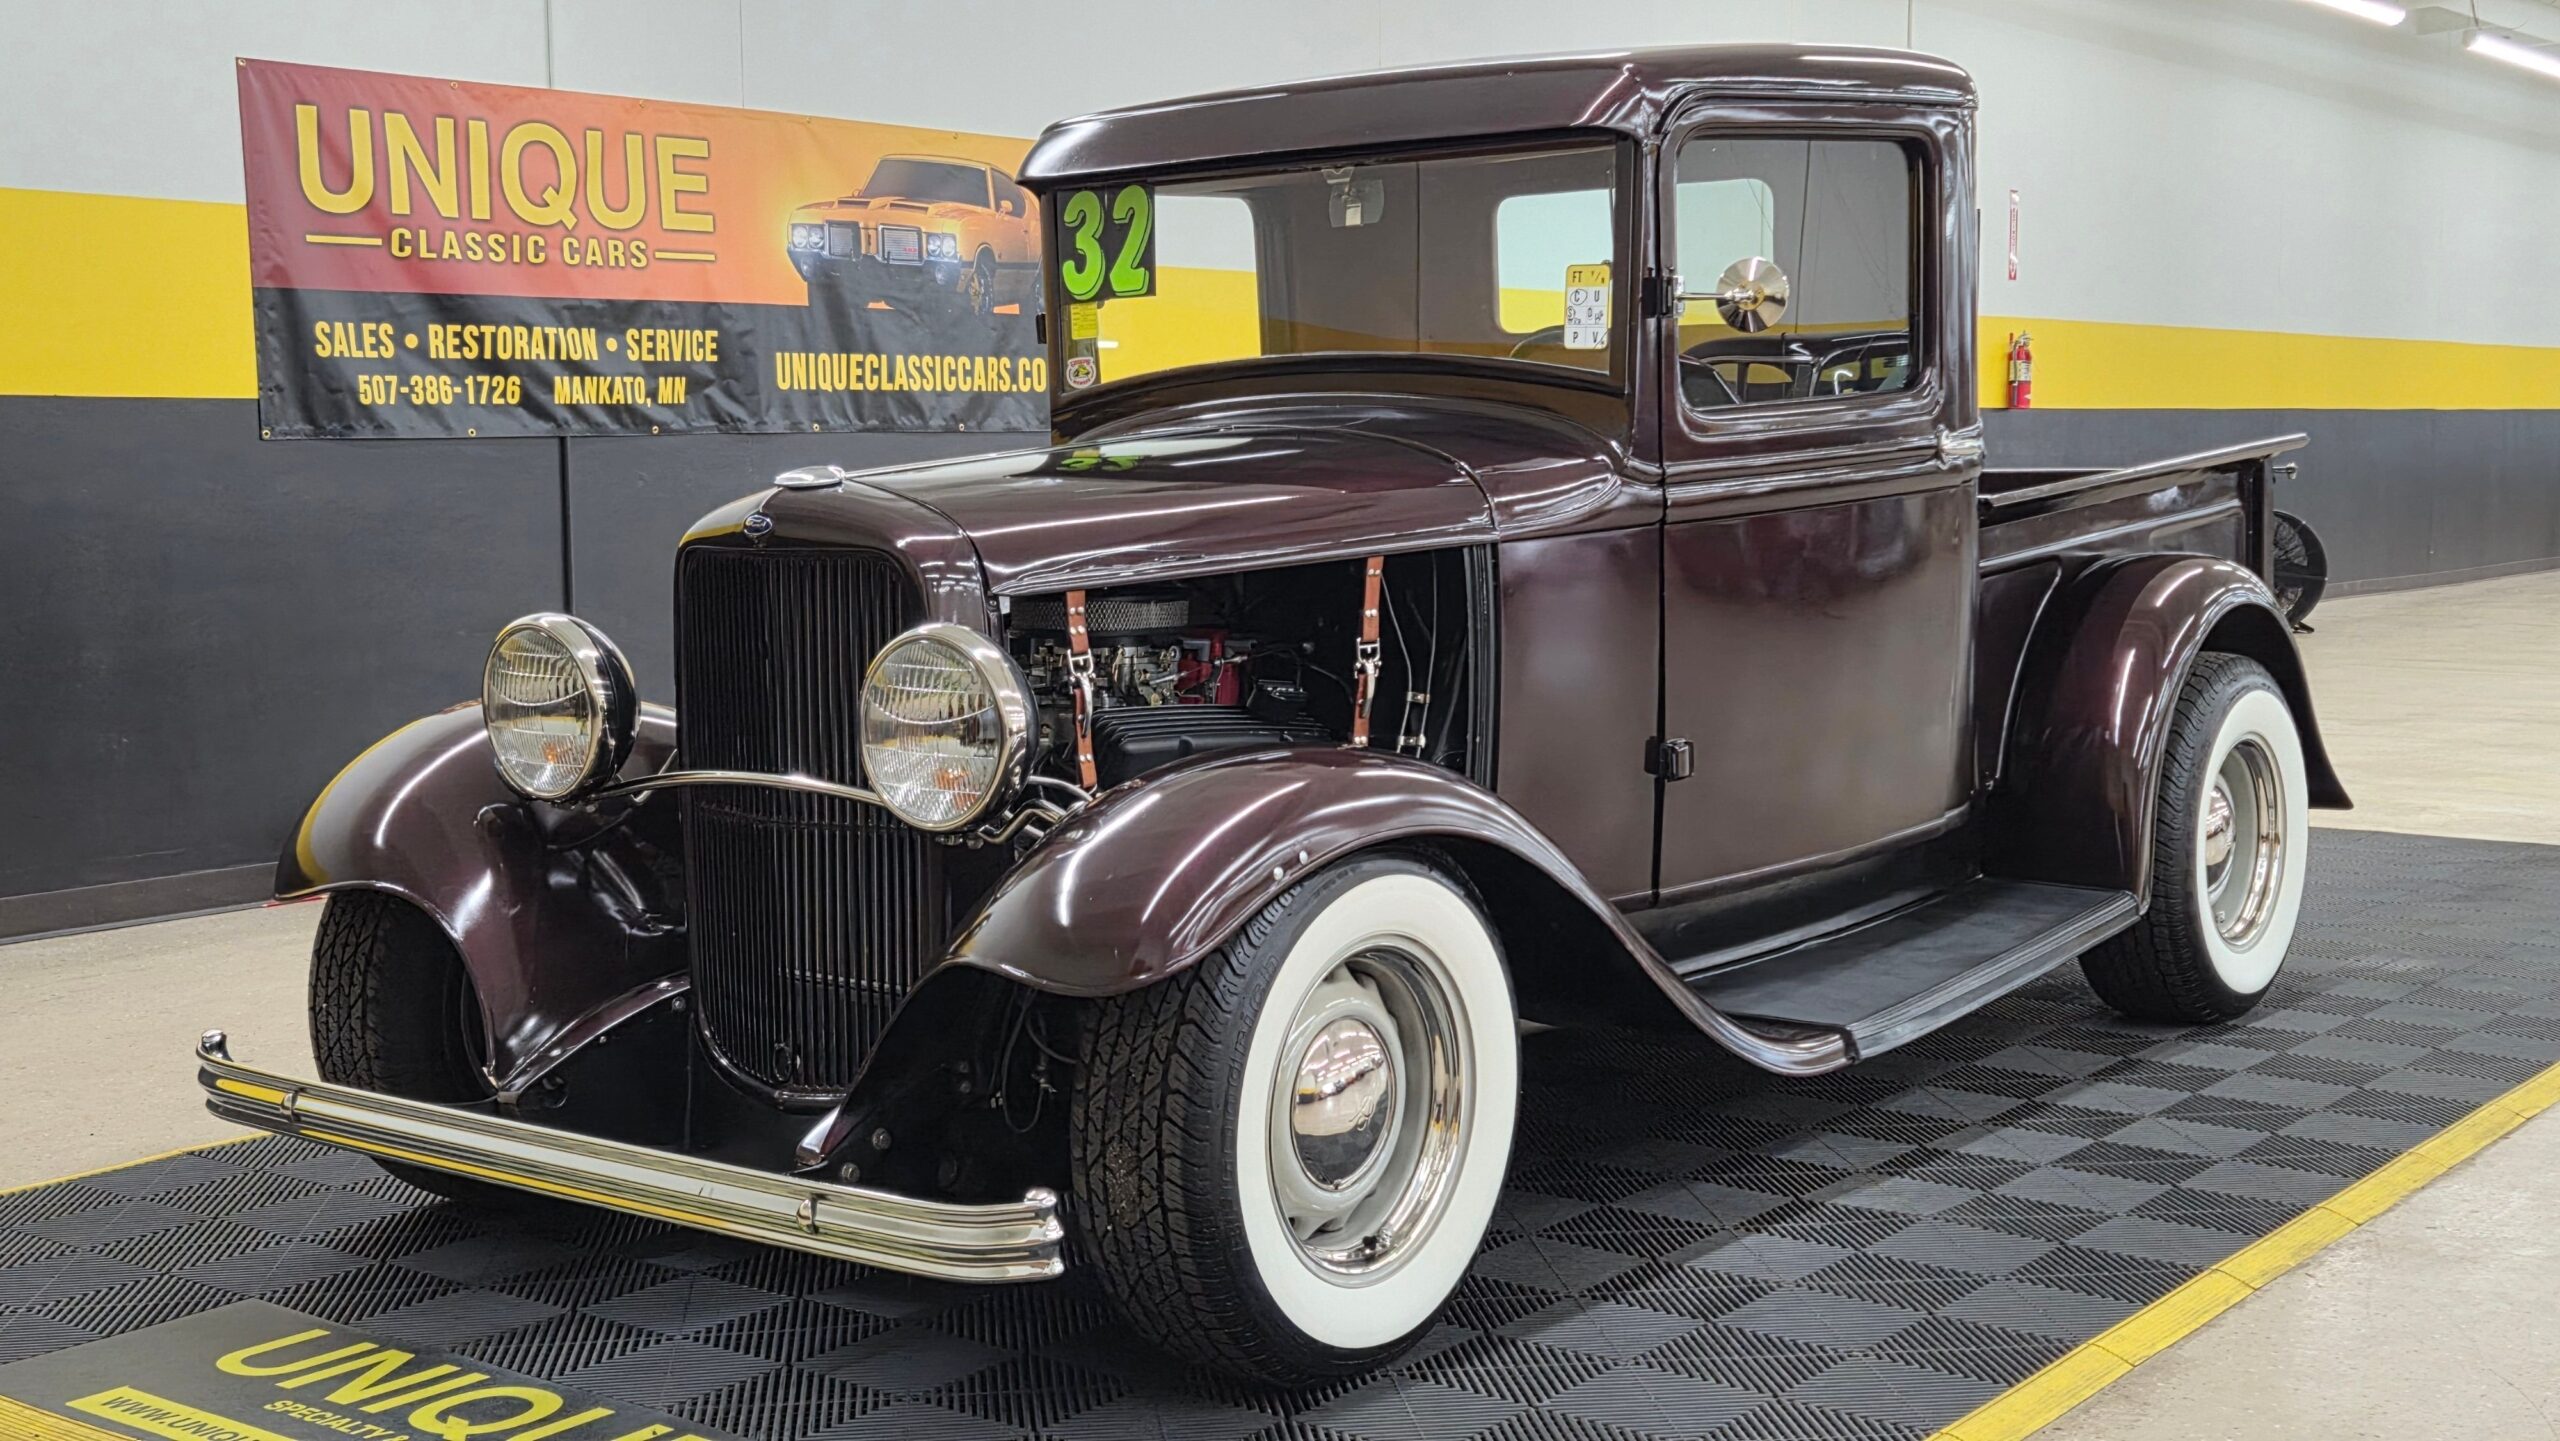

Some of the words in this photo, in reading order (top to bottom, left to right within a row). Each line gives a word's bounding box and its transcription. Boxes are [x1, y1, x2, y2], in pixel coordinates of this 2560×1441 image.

[295, 104, 715, 232] UNIQUE
[391, 228, 546, 264] CLASSIC
[563, 238, 649, 268] CARS
[1062, 185, 1153, 301] 32
[315, 321, 395, 359] SALES
[429, 324, 599, 361] RESTORATION
[626, 329, 718, 363] SERVICE
[358, 374, 521, 406] 507-386-1726
[554, 376, 652, 408] MANKATO,
[658, 376, 687, 405] MN
[775, 352, 1047, 393] UNIQUECLASSICCARS.CO
[215, 1328, 712, 1441] UNIQ
[101, 1396, 260, 1441] WWW.UNIQ
[263, 1400, 396, 1440] SPECIALTY
